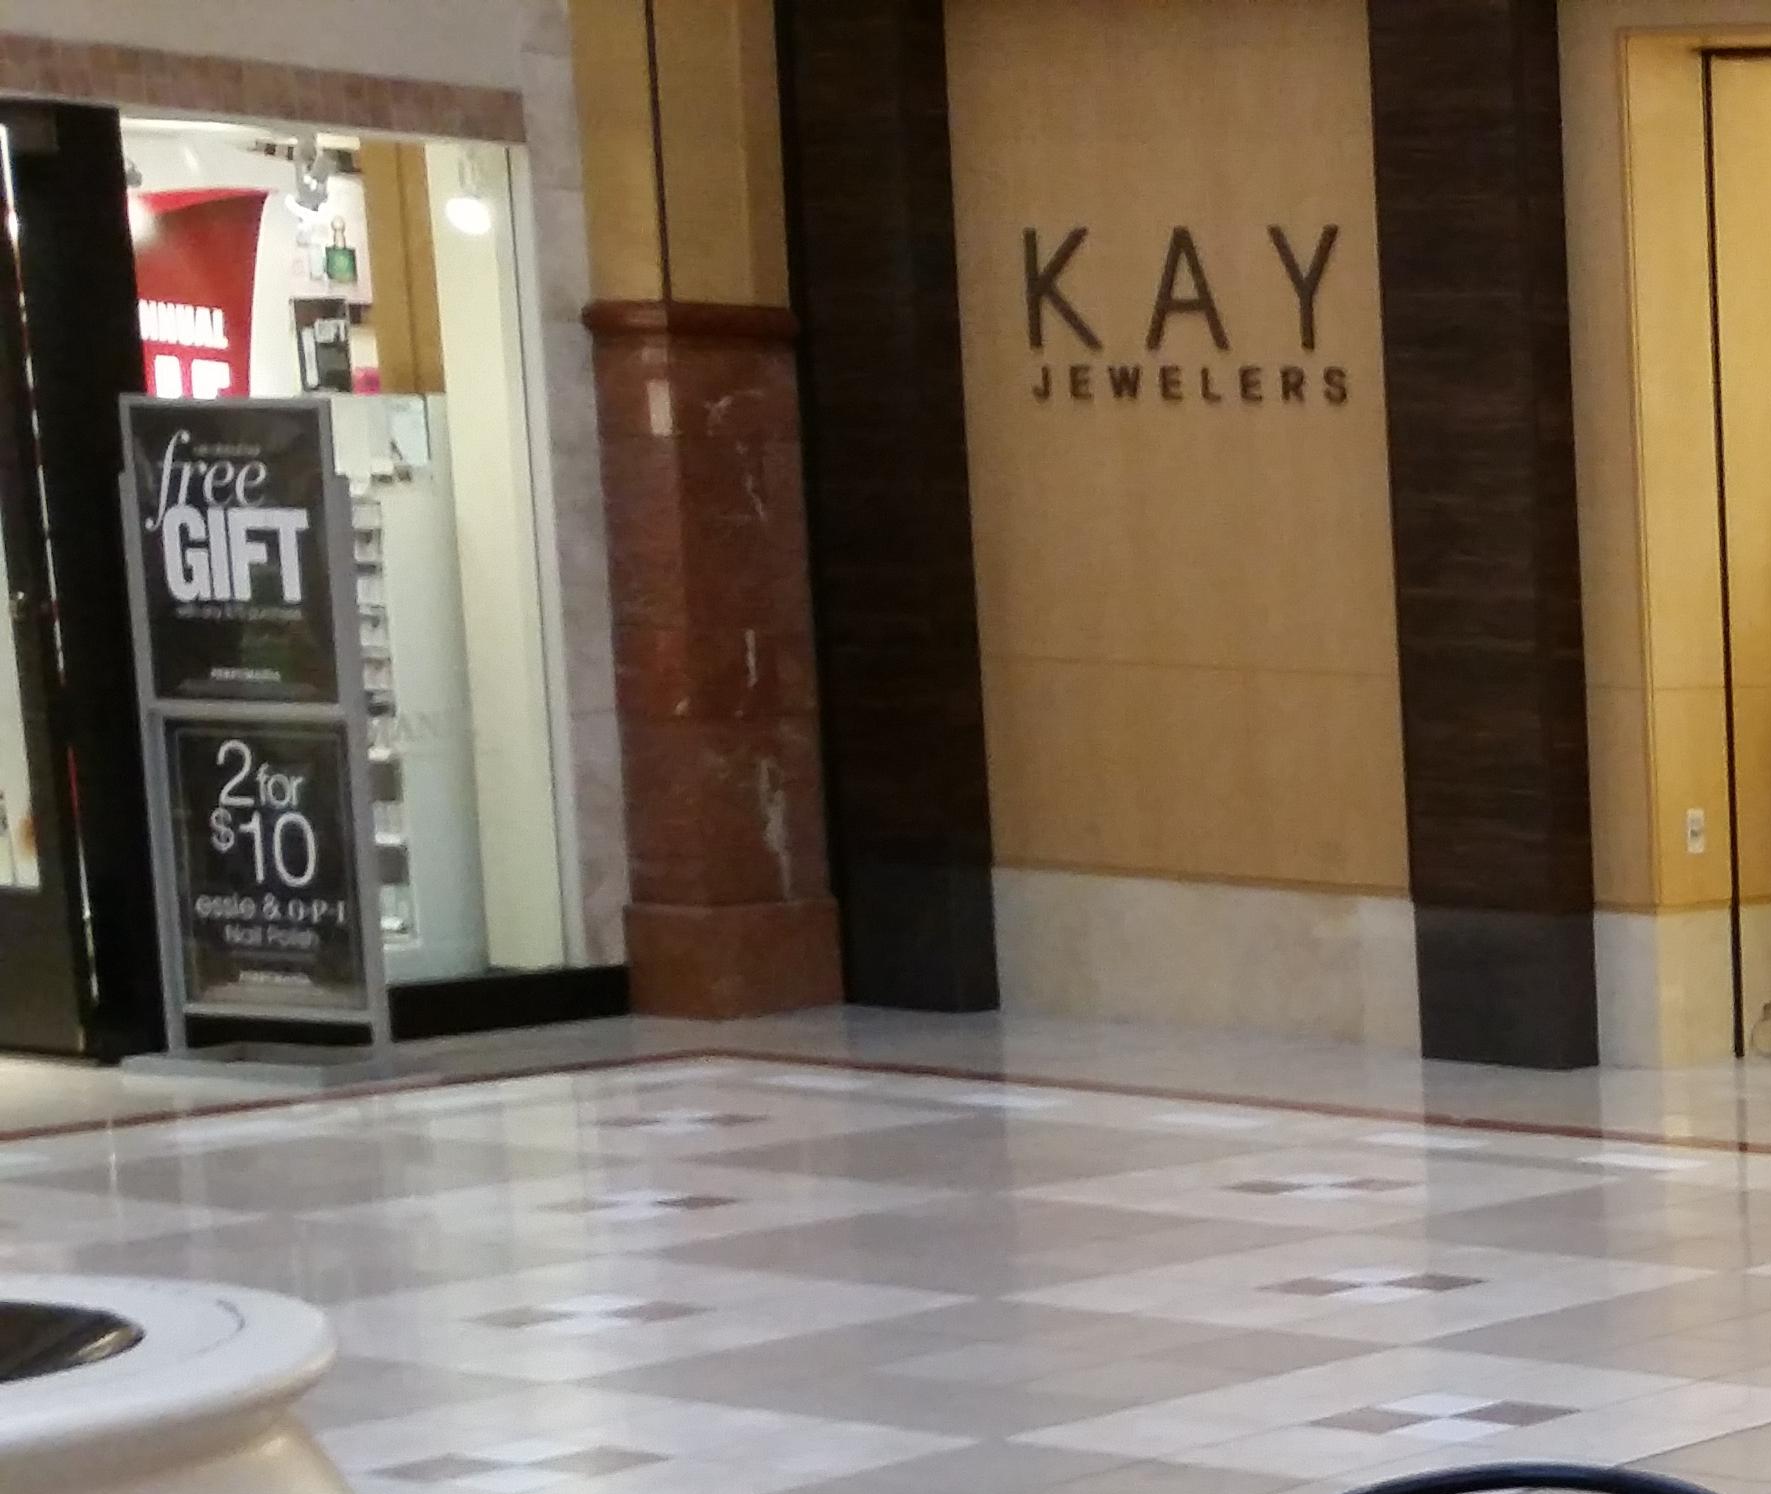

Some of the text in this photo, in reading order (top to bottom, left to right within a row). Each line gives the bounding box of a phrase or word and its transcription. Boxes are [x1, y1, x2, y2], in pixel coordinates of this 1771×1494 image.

[1022, 224, 1340, 352] KAY
[1032, 363, 1349, 402] JEWELERS
[145, 429, 267, 531] free
[163, 505, 309, 602] GIFT
[216, 739, 303, 808] 2 for
[210, 807, 317, 888] $10
[262, 892, 282, 920] &
